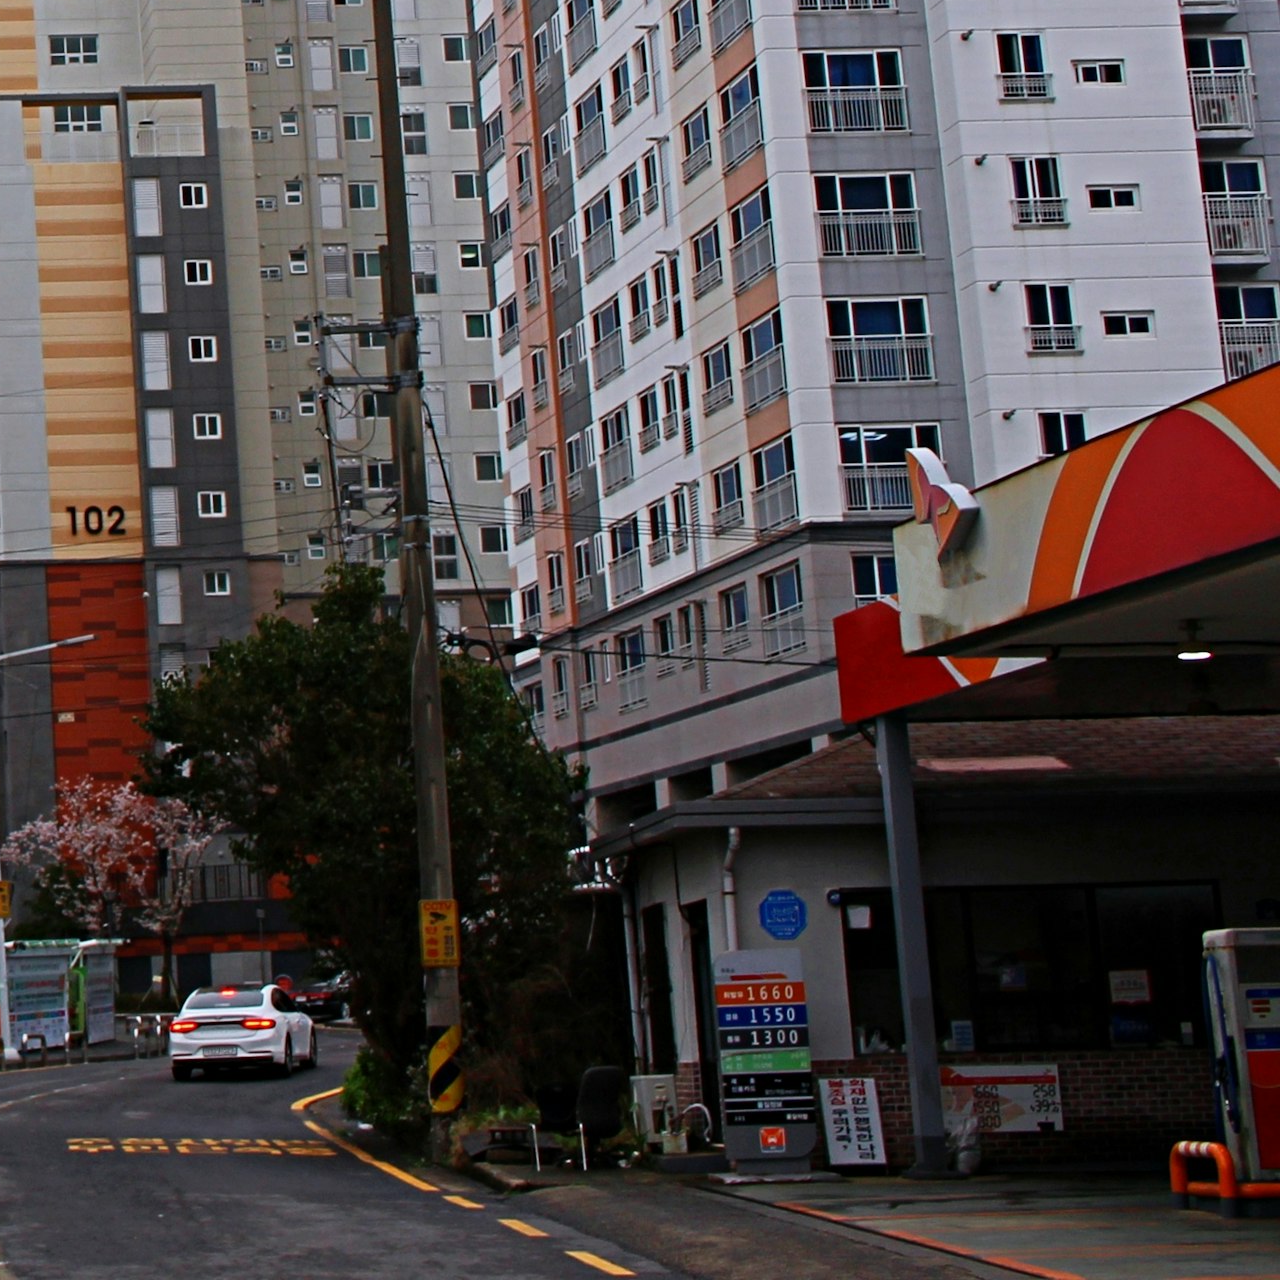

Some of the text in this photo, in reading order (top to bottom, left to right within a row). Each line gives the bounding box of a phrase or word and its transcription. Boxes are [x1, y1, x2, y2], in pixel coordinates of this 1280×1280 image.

[65, 505, 127, 536] 102
[747, 984, 794, 1001] 1660
[750, 1007, 796, 1024] 1550
[751, 1029, 798, 1046] 1300
